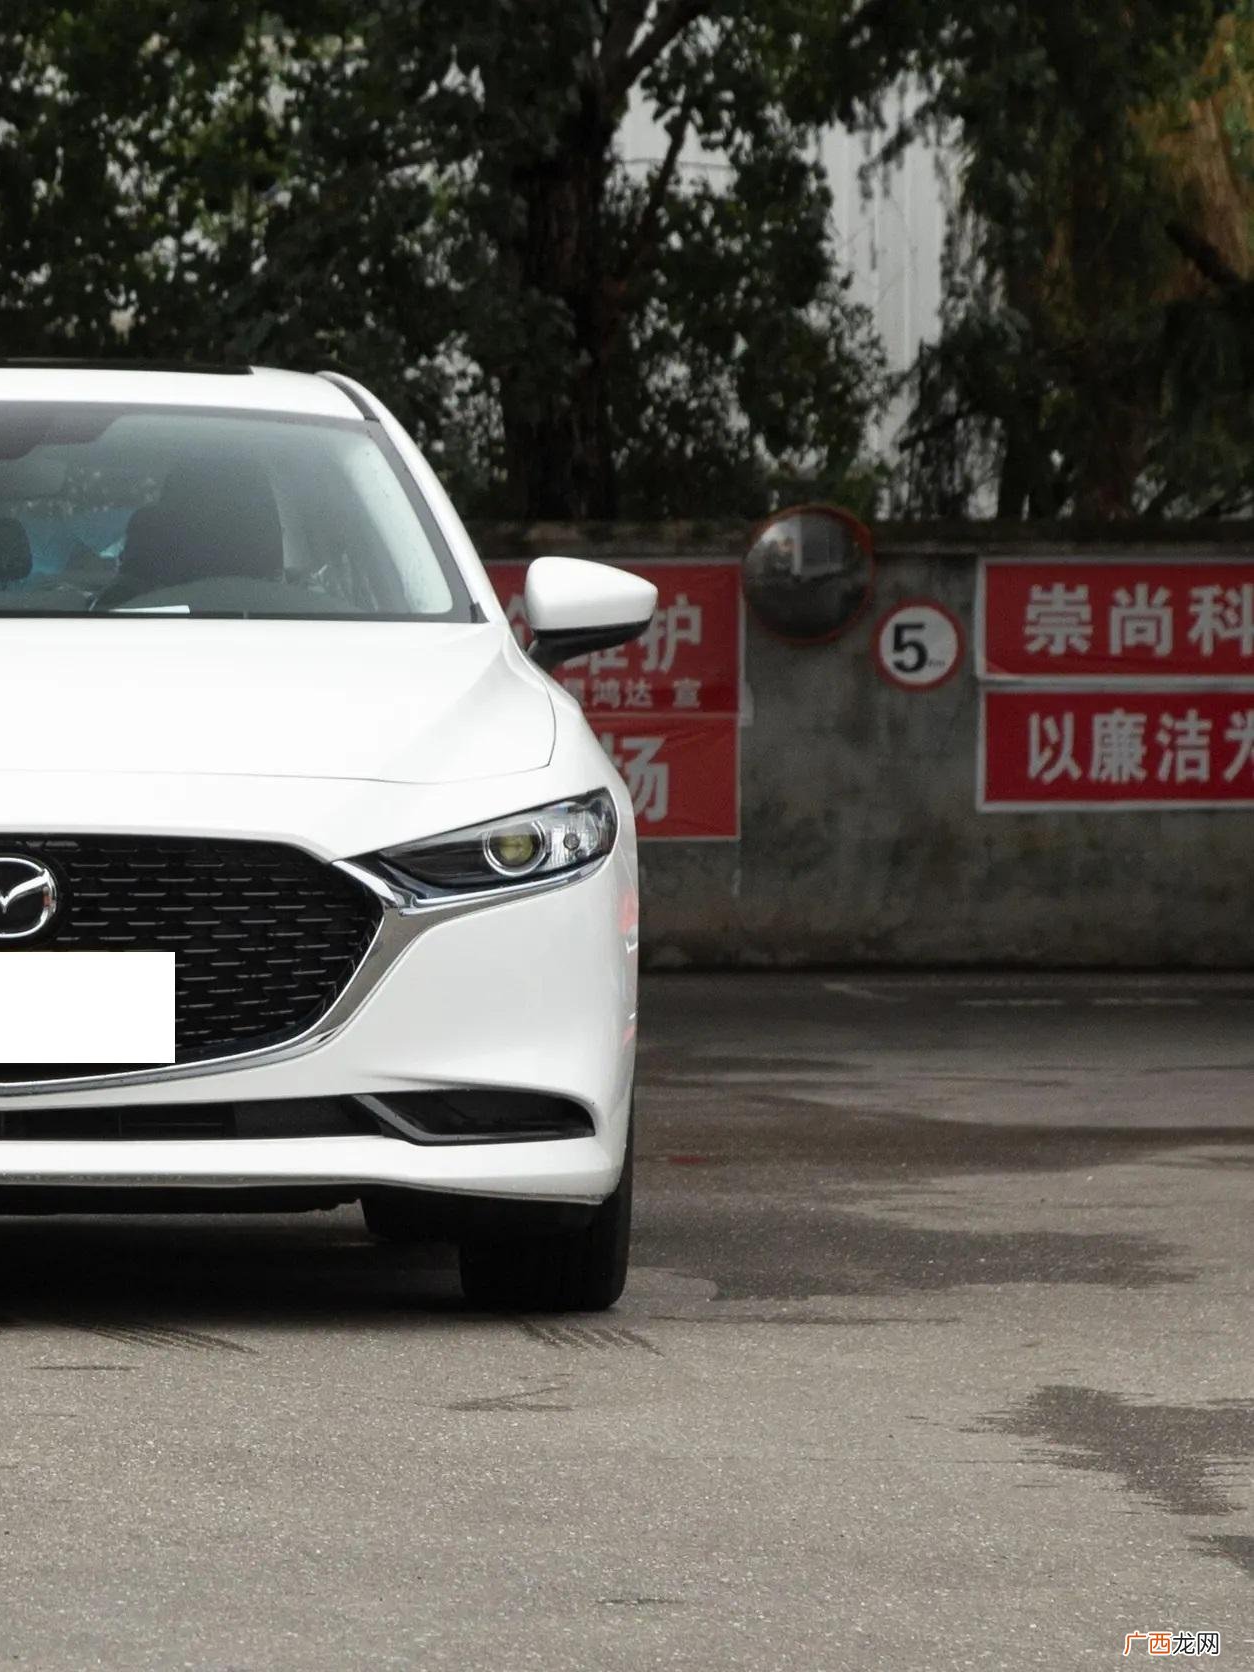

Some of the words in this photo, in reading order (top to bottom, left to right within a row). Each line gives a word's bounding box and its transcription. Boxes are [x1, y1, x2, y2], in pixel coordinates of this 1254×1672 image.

[892, 622, 928, 674] 5
[1023, 581, 1254, 657] 崇尚科
